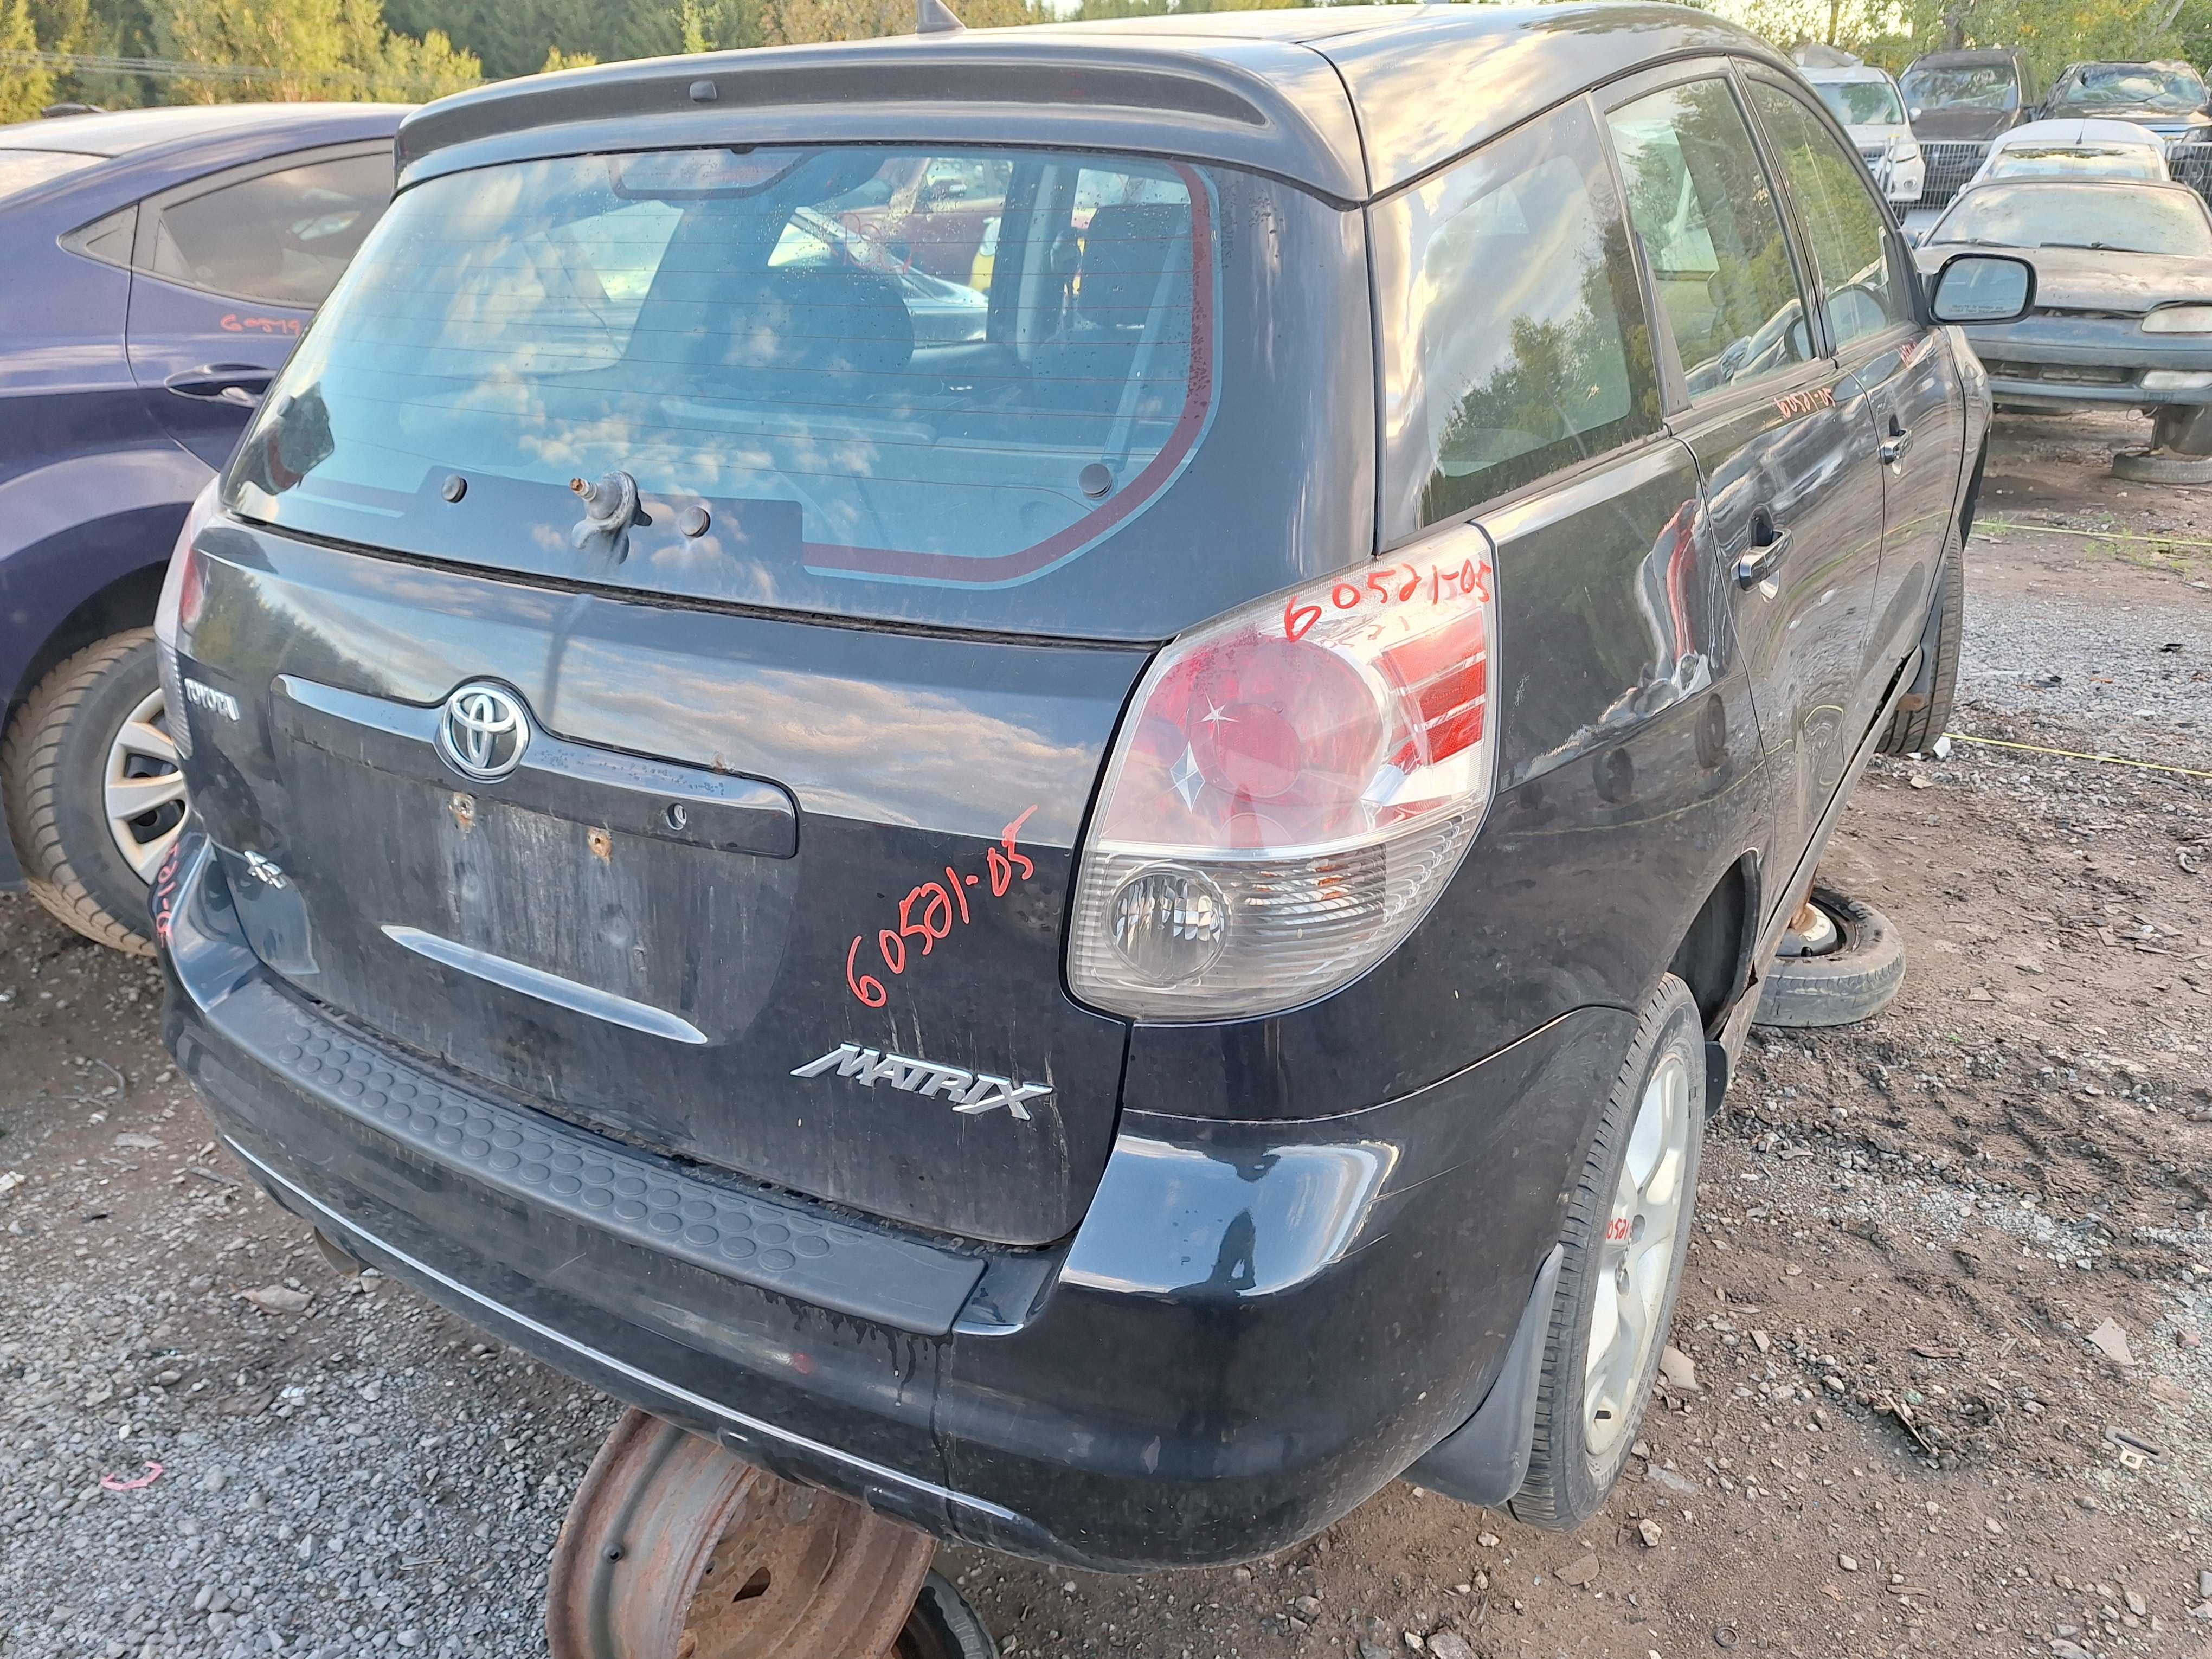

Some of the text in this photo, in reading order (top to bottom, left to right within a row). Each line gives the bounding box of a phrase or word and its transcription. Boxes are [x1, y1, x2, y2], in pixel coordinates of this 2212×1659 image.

[1284, 558, 1491, 643] 60521-05
[184, 678, 240, 721] TOYOTA
[846, 805, 1039, 1008] 60521-05
[789, 1042, 1053, 1121] MATRIX
